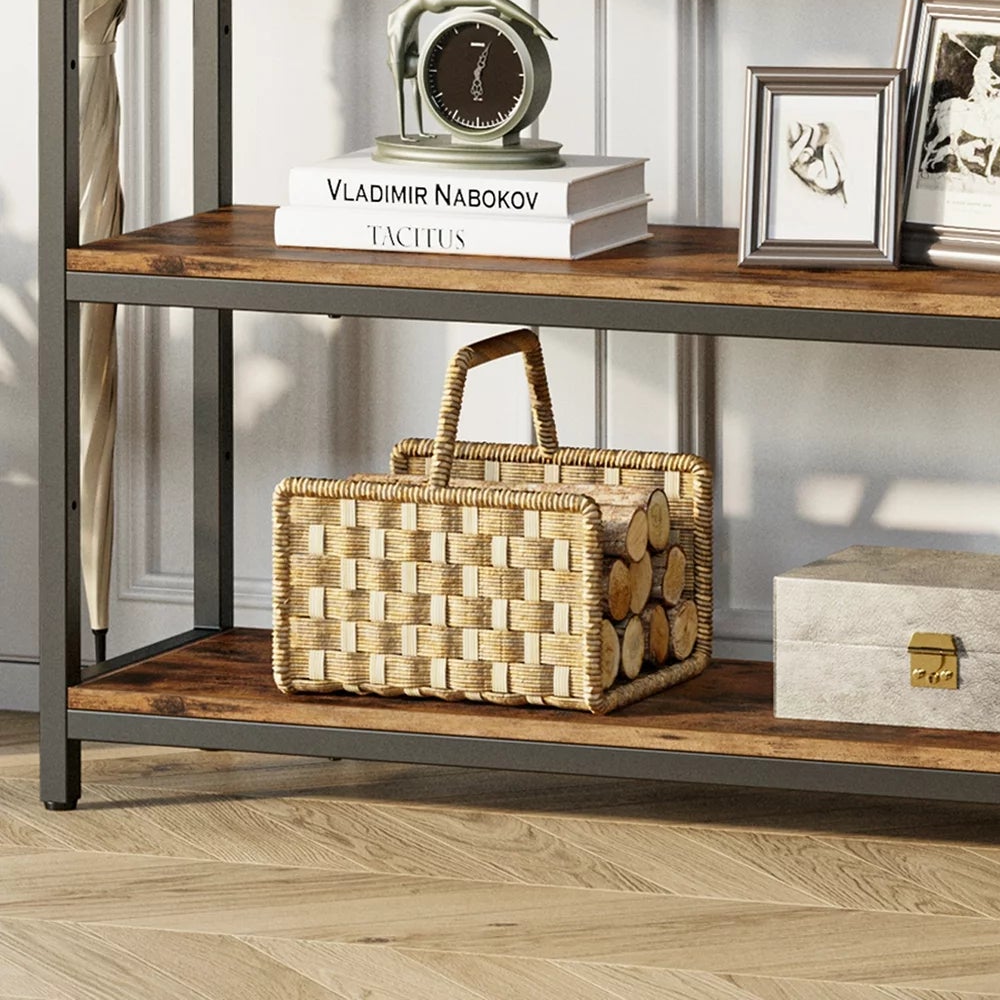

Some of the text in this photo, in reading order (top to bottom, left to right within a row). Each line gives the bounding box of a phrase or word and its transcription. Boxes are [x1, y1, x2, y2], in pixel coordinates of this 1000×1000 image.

[326, 178, 539, 210] VLADIMIR NABOKOV
[366, 224, 466, 250] TACITUS
